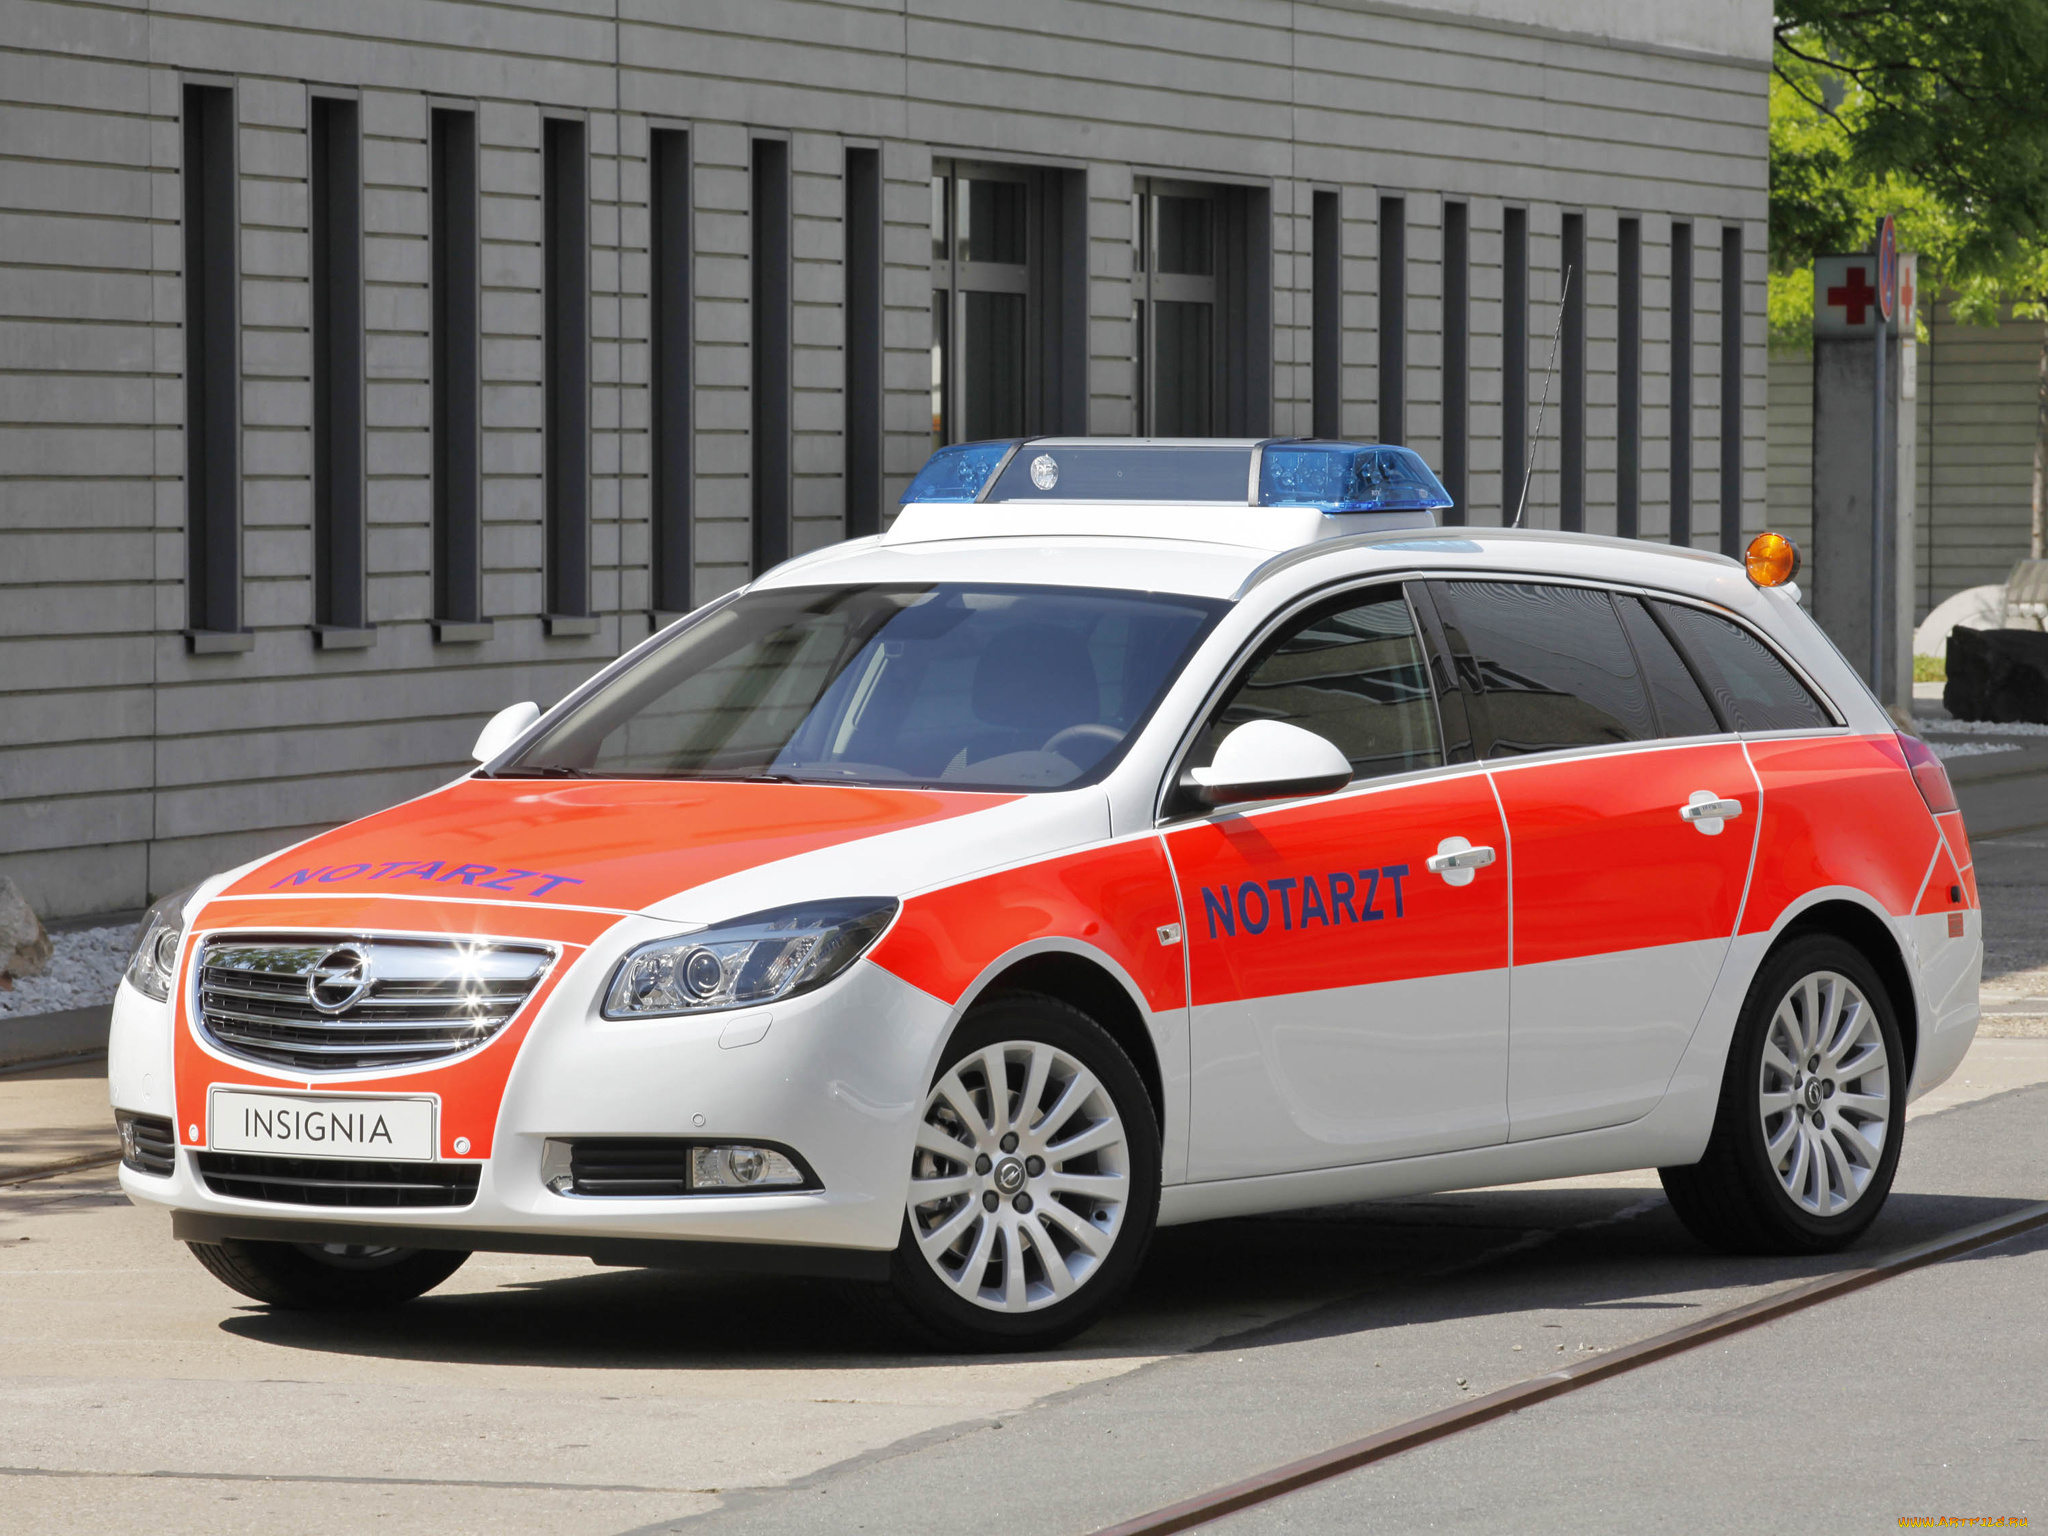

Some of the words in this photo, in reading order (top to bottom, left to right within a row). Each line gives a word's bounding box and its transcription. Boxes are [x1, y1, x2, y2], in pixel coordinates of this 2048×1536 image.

[269, 860, 584, 896] NOTARZT
[1201, 864, 1409, 939] NOTARZT
[244, 1107, 393, 1143] INSIGNIA
